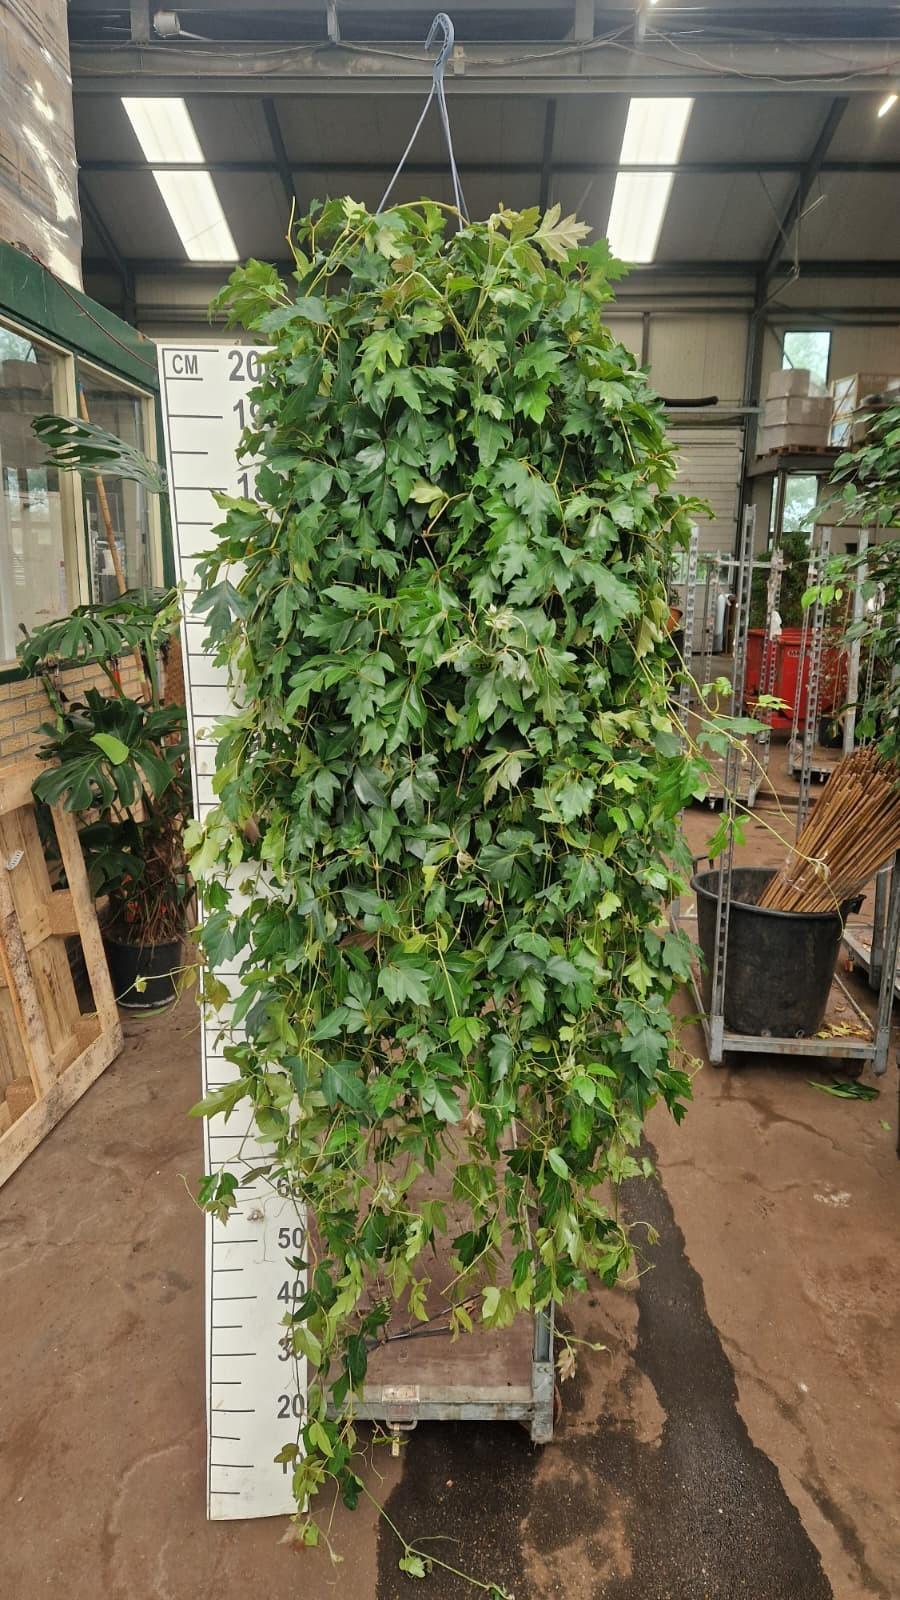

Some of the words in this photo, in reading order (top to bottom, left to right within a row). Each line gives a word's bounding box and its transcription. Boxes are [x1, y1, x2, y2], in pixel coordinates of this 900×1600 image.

[172, 354, 198, 375] CM
[227, 350, 276, 382] 20
[278, 1228, 304, 1249] 50
[277, 1280, 305, 1304] 40
[277, 1394, 305, 1418] 20
